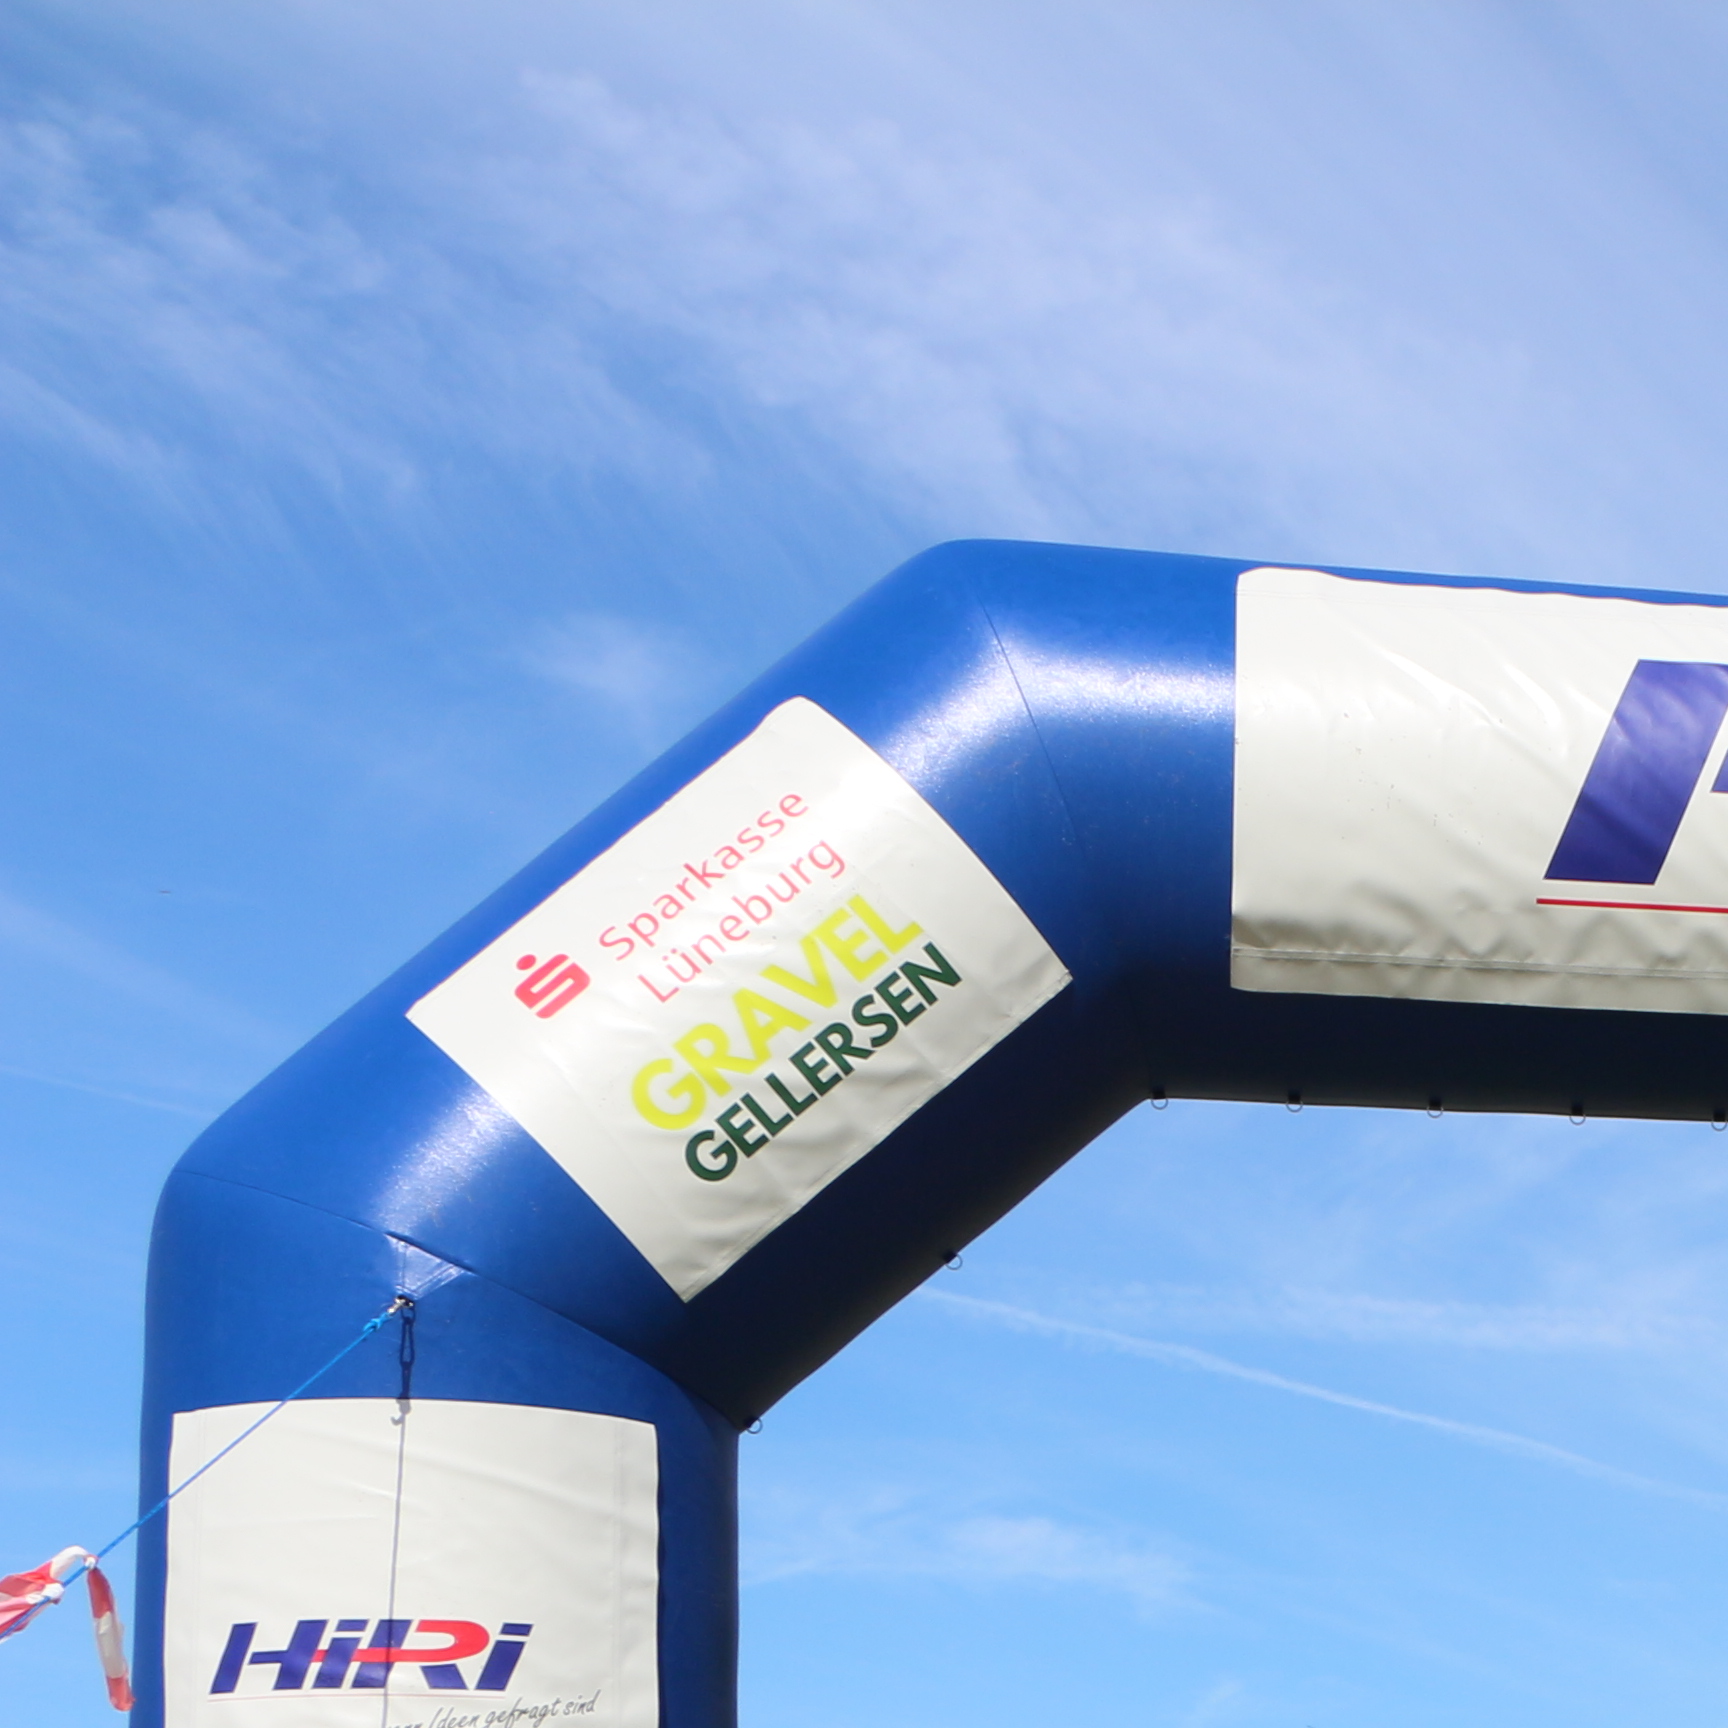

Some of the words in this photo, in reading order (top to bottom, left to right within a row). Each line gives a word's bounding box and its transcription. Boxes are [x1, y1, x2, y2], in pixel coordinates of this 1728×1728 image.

[599, 792, 809, 961] Sparkasse
[637, 836, 846, 1003] Lüneburg
[631, 894, 923, 1130] GRAVEL
[685, 942, 963, 1182] GELLERSEN
[563, 1689, 602, 1715] sind
